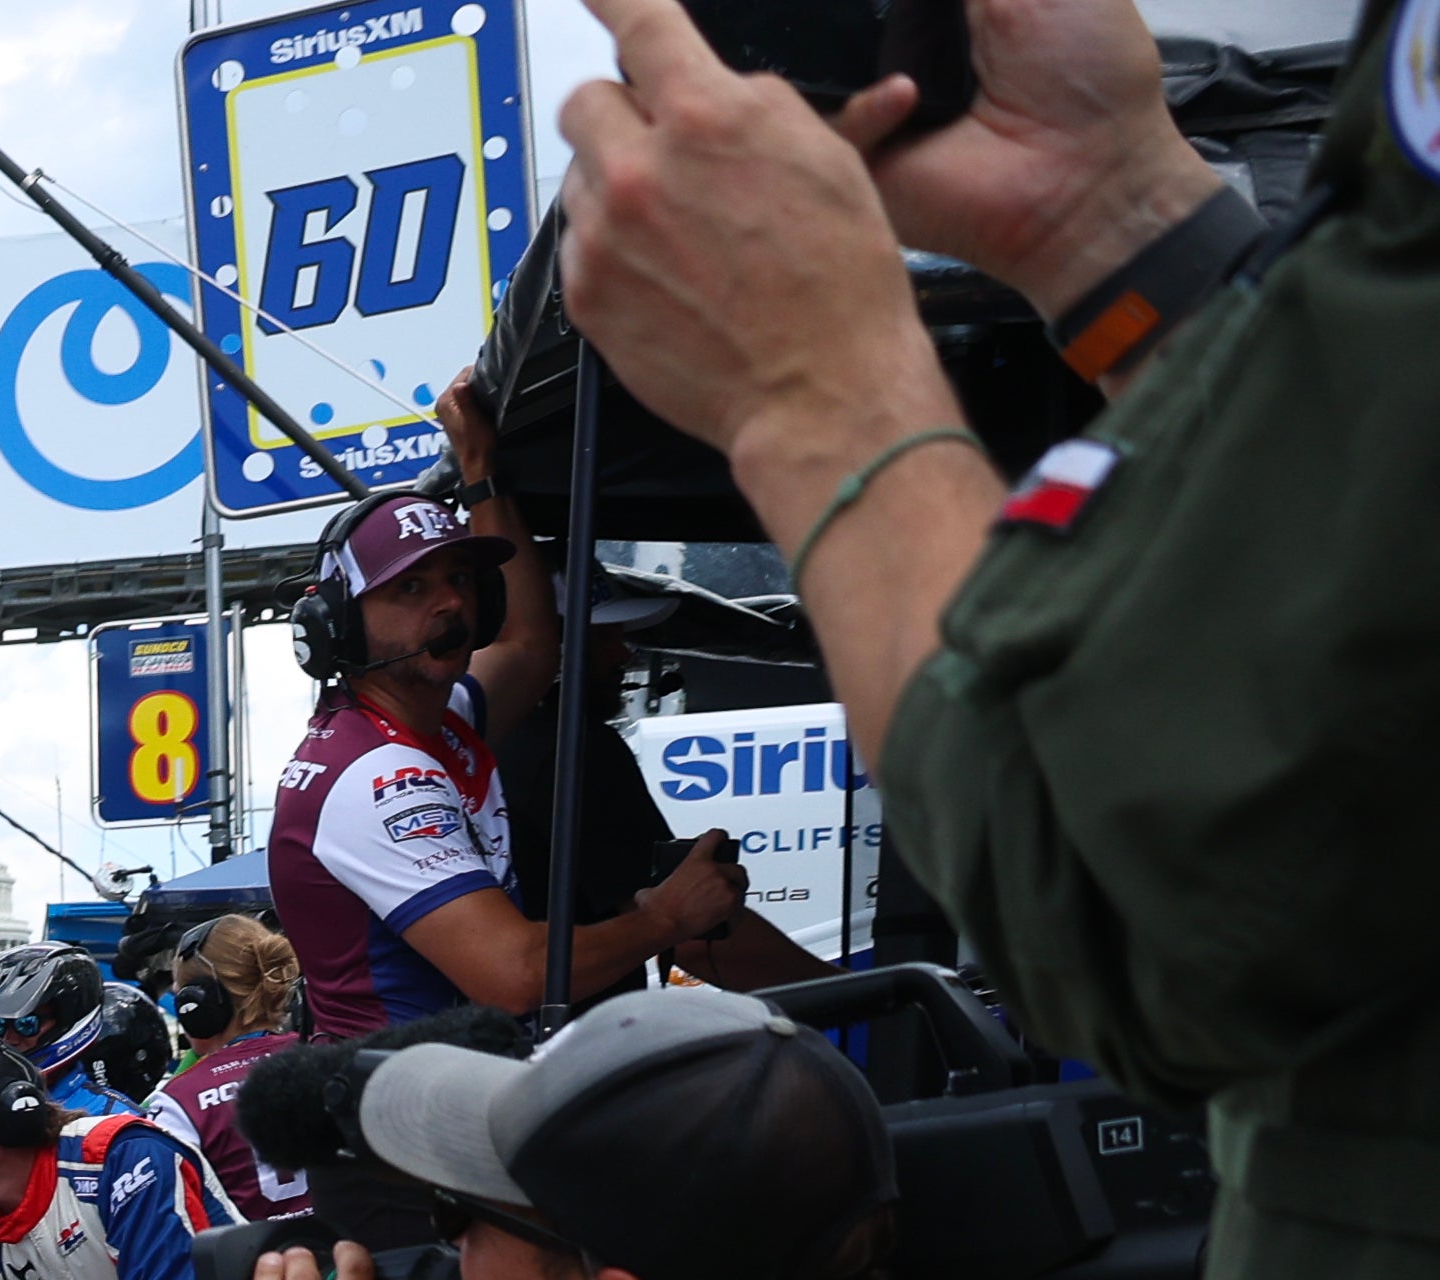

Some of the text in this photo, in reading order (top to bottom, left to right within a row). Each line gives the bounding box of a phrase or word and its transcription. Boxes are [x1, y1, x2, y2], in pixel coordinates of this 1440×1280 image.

[270, 7, 424, 64] SiriusXM
[256, 152, 467, 336] 60
[299, 430, 445, 480] SriusXM
[133, 640, 189, 656] SUNOCO
[127, 689, 200, 804] 8
[372, 766, 449, 802] HRC
[1109, 1126, 1133, 1145] 14
